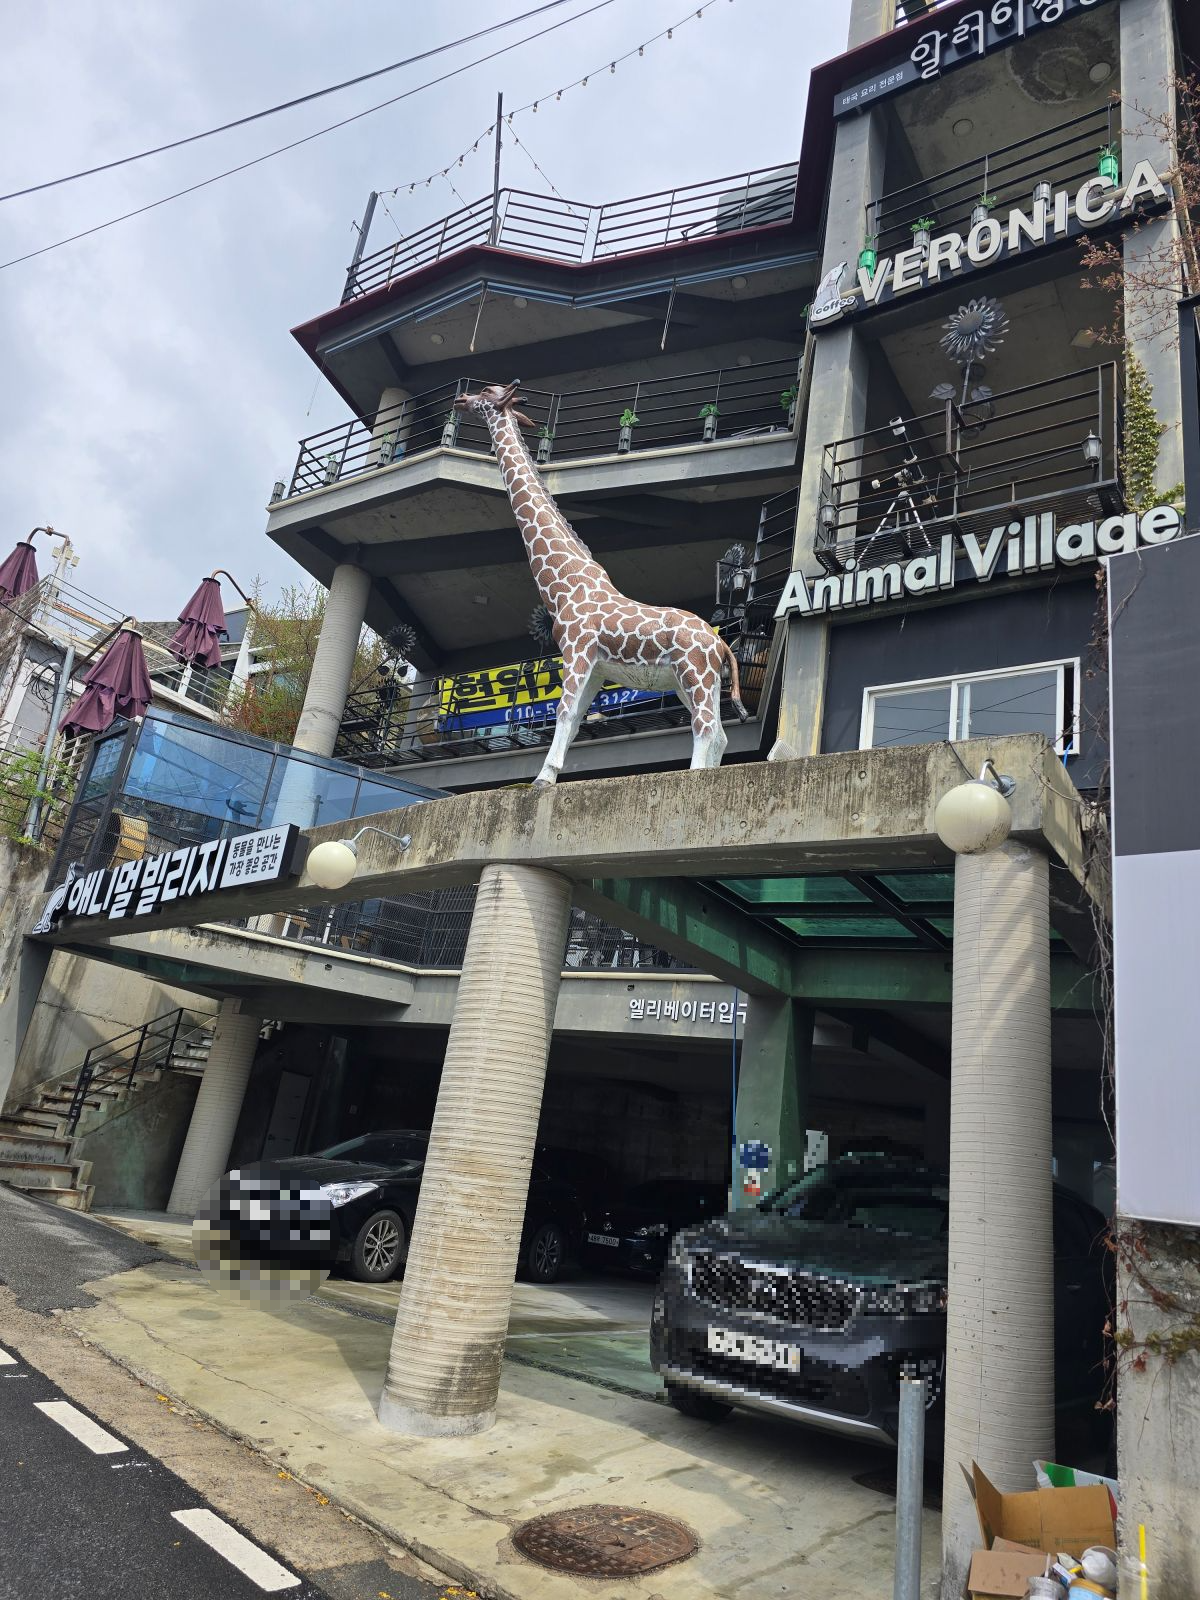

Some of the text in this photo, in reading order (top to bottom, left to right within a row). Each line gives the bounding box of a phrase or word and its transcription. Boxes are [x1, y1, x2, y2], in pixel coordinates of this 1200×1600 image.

[861, 83, 877, 97] 요리
[879, 71, 903, 88] 전문점
[857, 159, 1167, 303] VERONICA
[815, 296, 856, 315] coffee
[774, 534, 954, 621] Animal
[232, 833, 281, 859] 동물을 만나는
[229, 859, 245, 877] 가장
[261, 852, 278, 872] 공간
